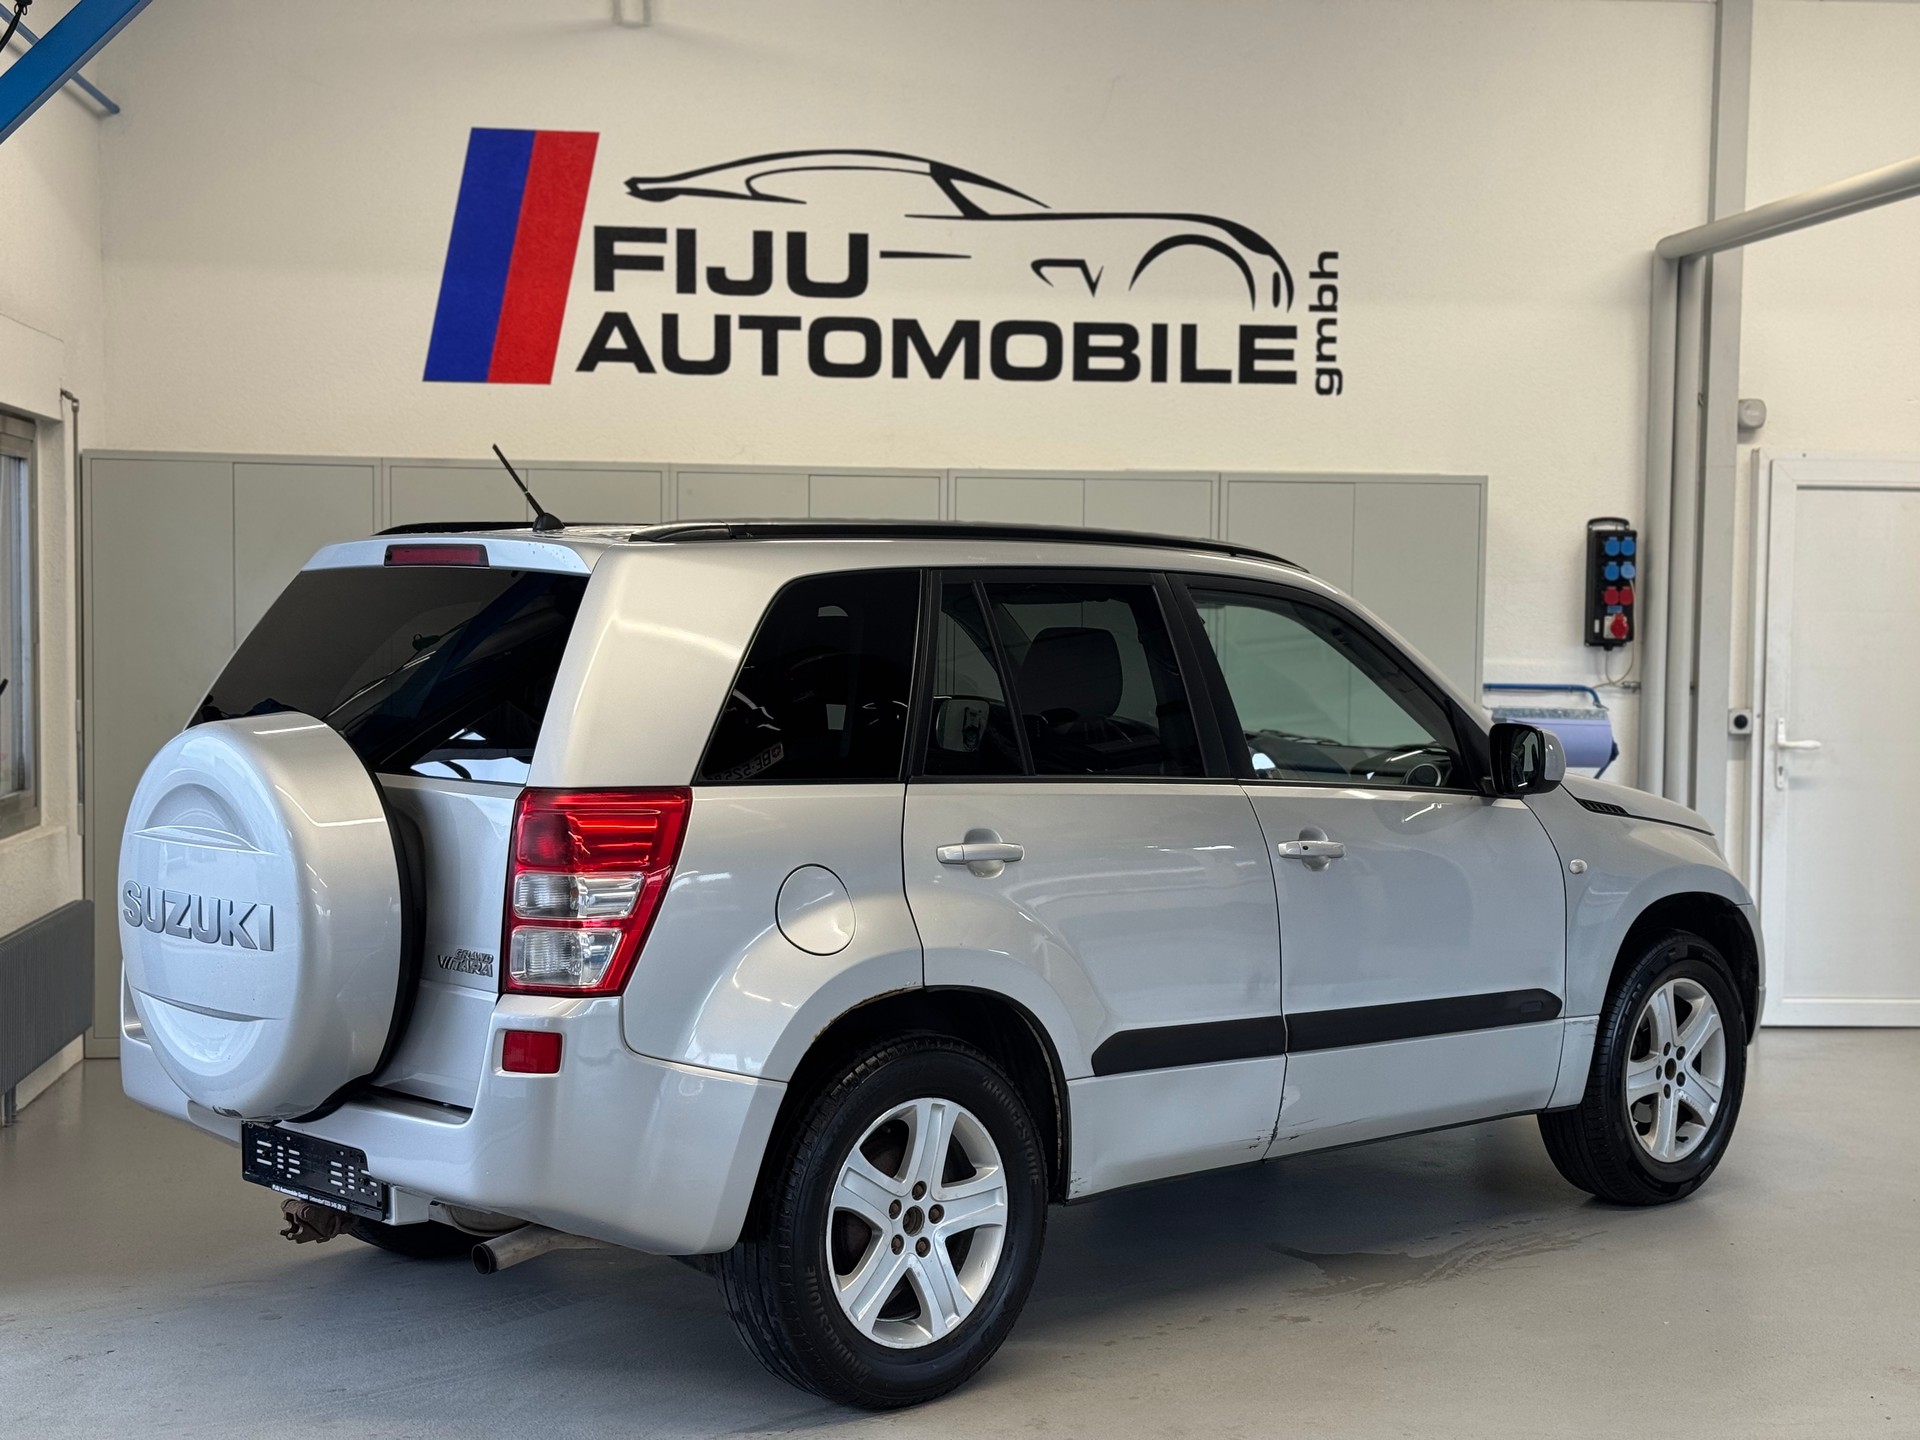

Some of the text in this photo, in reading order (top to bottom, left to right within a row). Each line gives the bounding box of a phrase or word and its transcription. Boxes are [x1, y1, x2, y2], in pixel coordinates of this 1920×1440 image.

[593, 225, 869, 299] FIJU
[575, 311, 1298, 385] AUTOMOBILE
[1309, 251, 1343, 396] gmbh
[122, 879, 274, 952] SUZUKI
[437, 954, 494, 978] VITARA
[454, 948, 495, 965] GRAND
[806, 1263, 873, 1386] BRIDGESTONE
